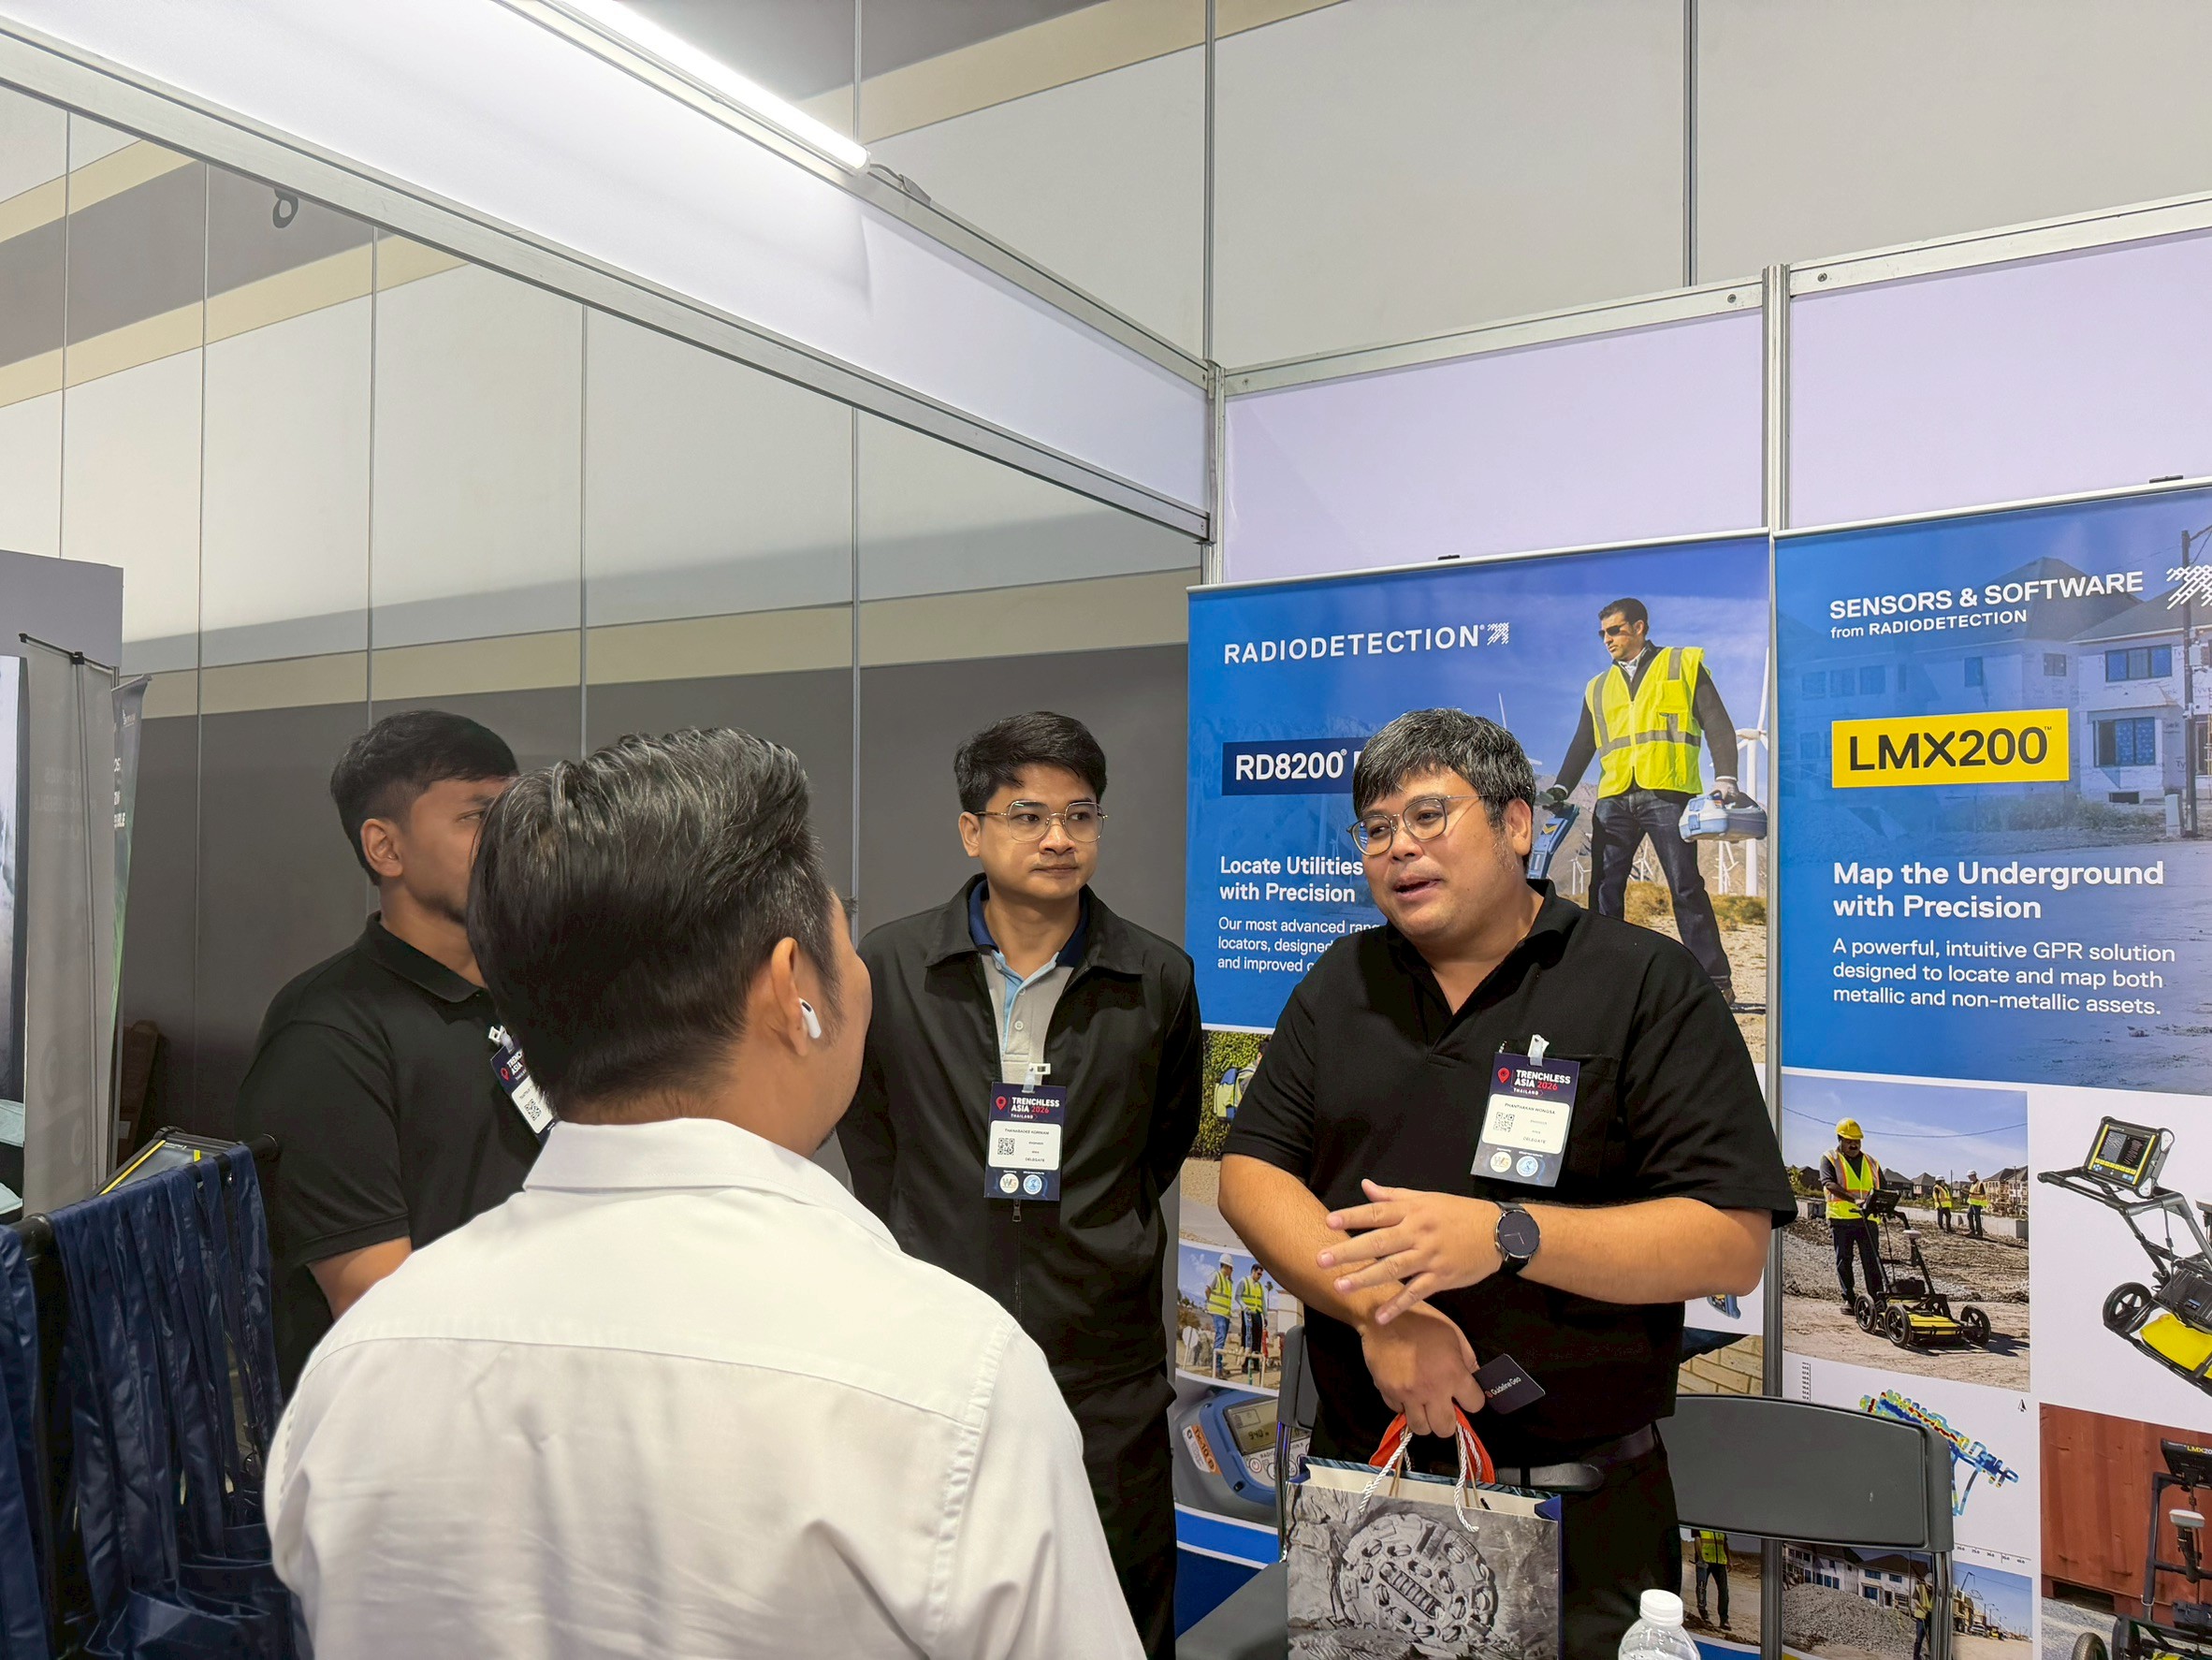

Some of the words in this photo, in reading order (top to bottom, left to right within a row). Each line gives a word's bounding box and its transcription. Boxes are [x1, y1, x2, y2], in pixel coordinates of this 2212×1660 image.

[1830, 590, 1953, 619] SENSORS
[1958, 588, 1978, 607] &
[1985, 571, 2143, 605] SOFTWARE
[1830, 626, 1864, 639] from
[1869, 609, 2027, 636] RADIODETECTION
[1220, 856, 1281, 874] Locate
[1287, 856, 1364, 875] Utilities
[1833, 862, 1893, 889] Map
[1900, 863, 1949, 884] the
[1958, 861, 2164, 890] Underground
[1219, 882, 1259, 900] with
[1265, 882, 1356, 902] Precision
[1833, 895, 1894, 917] with
[1903, 895, 2042, 919] Precision
[1218, 917, 1242, 930] Our
[1245, 919, 1277, 931] most
[1280, 919, 1346, 934] advanced
[1218, 937, 1271, 953] locators,
[1832, 938, 1847, 954] A
[1851, 939, 1940, 957] powerful,
[1945, 940, 2028, 958] intuitive
[2032, 941, 2083, 960] GPR
[2088, 944, 2176, 962] solution
[1217, 956, 1241, 969] and
[1244, 957, 1303, 973] improved
[1832, 963, 1916, 983] designed
[1923, 966, 1943, 981] to
[1948, 965, 2010, 983] locate
[2016, 968, 2054, 984] and
[2060, 971, 2106, 990] map
[2113, 970, 2163, 988] both
[1833, 987, 1905, 1004] metallic
[1910, 990, 1945, 1006] and
[1952, 992, 2079, 1011] non-metallic
[2086, 997, 2161, 1014] assets.
[1515, 1079, 1535, 1087] ASIA
[1537, 1082, 1558, 1091] 2026
[1516, 1070, 1571, 1084] TRENCHLESS
[1011, 1097, 1060, 1107] TRENCHLESS
